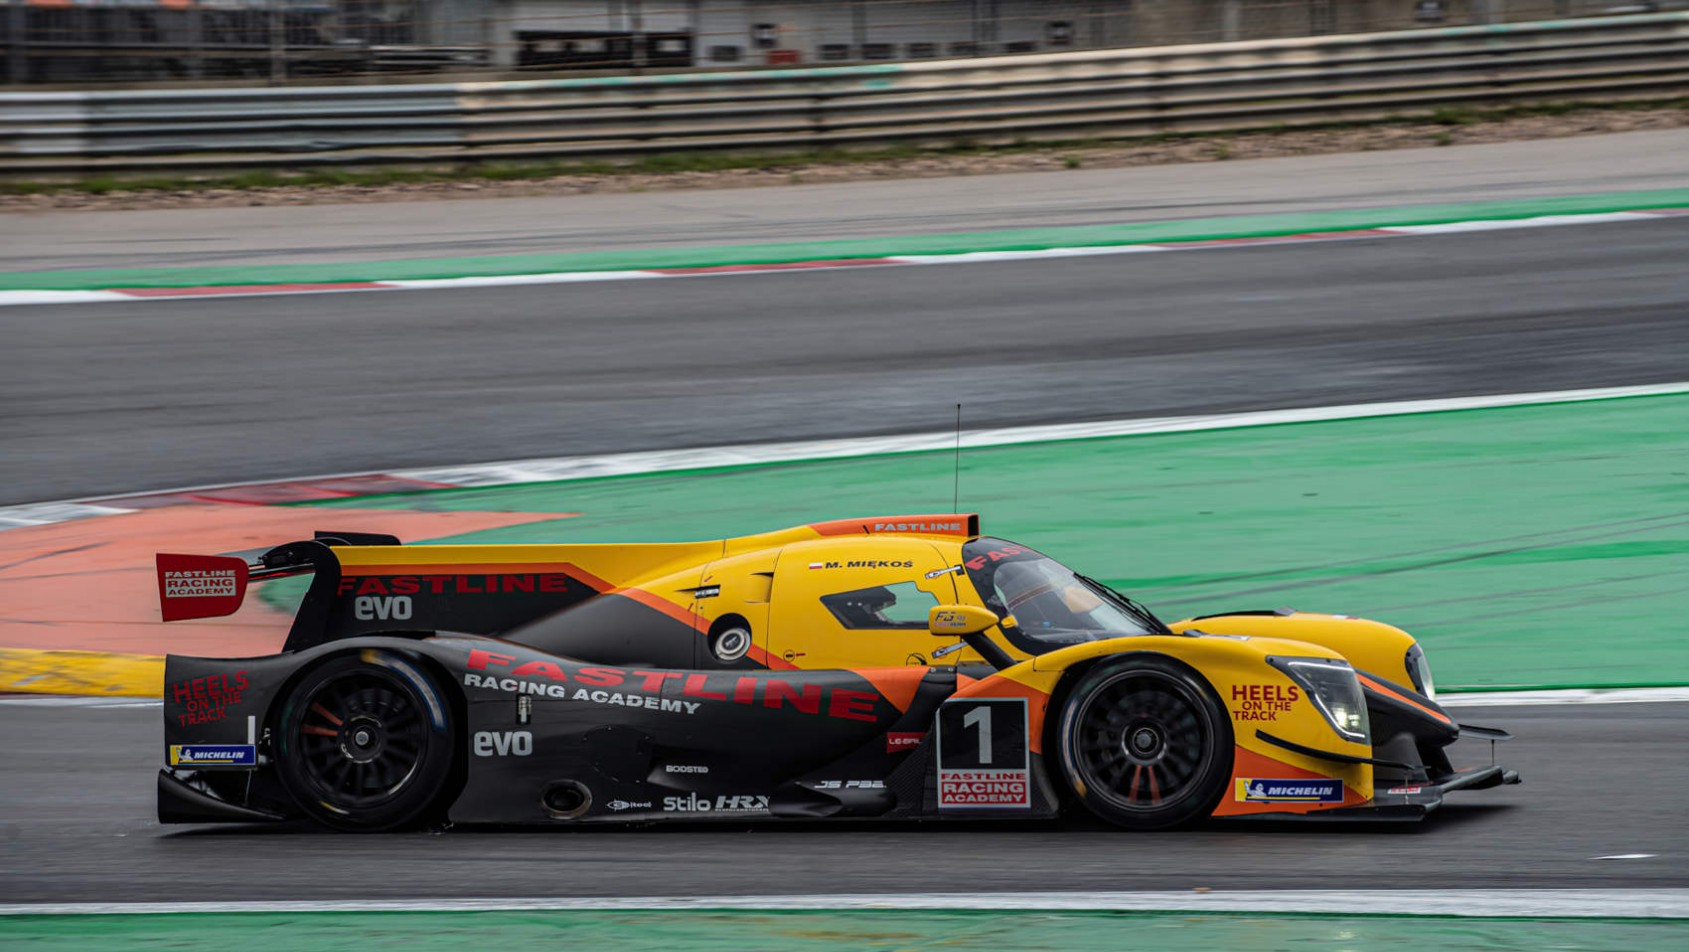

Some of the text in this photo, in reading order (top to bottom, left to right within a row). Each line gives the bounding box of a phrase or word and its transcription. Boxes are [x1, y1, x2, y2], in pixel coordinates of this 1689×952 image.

[874, 523, 961, 531] FASTLINE
[165, 570, 235, 578] FASTLINE
[167, 578, 234, 588] RACING
[337, 574, 568, 596] FASTLINE
[168, 587, 233, 595] ACADEMY
[355, 595, 413, 621] evo
[172, 670, 249, 704] HEELS
[467, 648, 880, 723] FASTLINE
[464, 673, 701, 715] RACING ACADEMY
[1231, 685, 1299, 701] HEELS
[187, 691, 242, 712] ON THE
[1242, 701, 1291, 711] ON THE
[178, 706, 227, 727] TRACK
[1233, 711, 1277, 721] TRACK
[963, 706, 992, 764] 1
[474, 731, 533, 757] evo
[194, 751, 245, 759] MICHELIN
[665, 765, 709, 773] BOOSTED
[943, 783, 1024, 793] RACING
[1268, 786, 1333, 796] MICHELIN
[663, 792, 711, 811] Stilo
[944, 794, 1024, 803] ACADEMY
